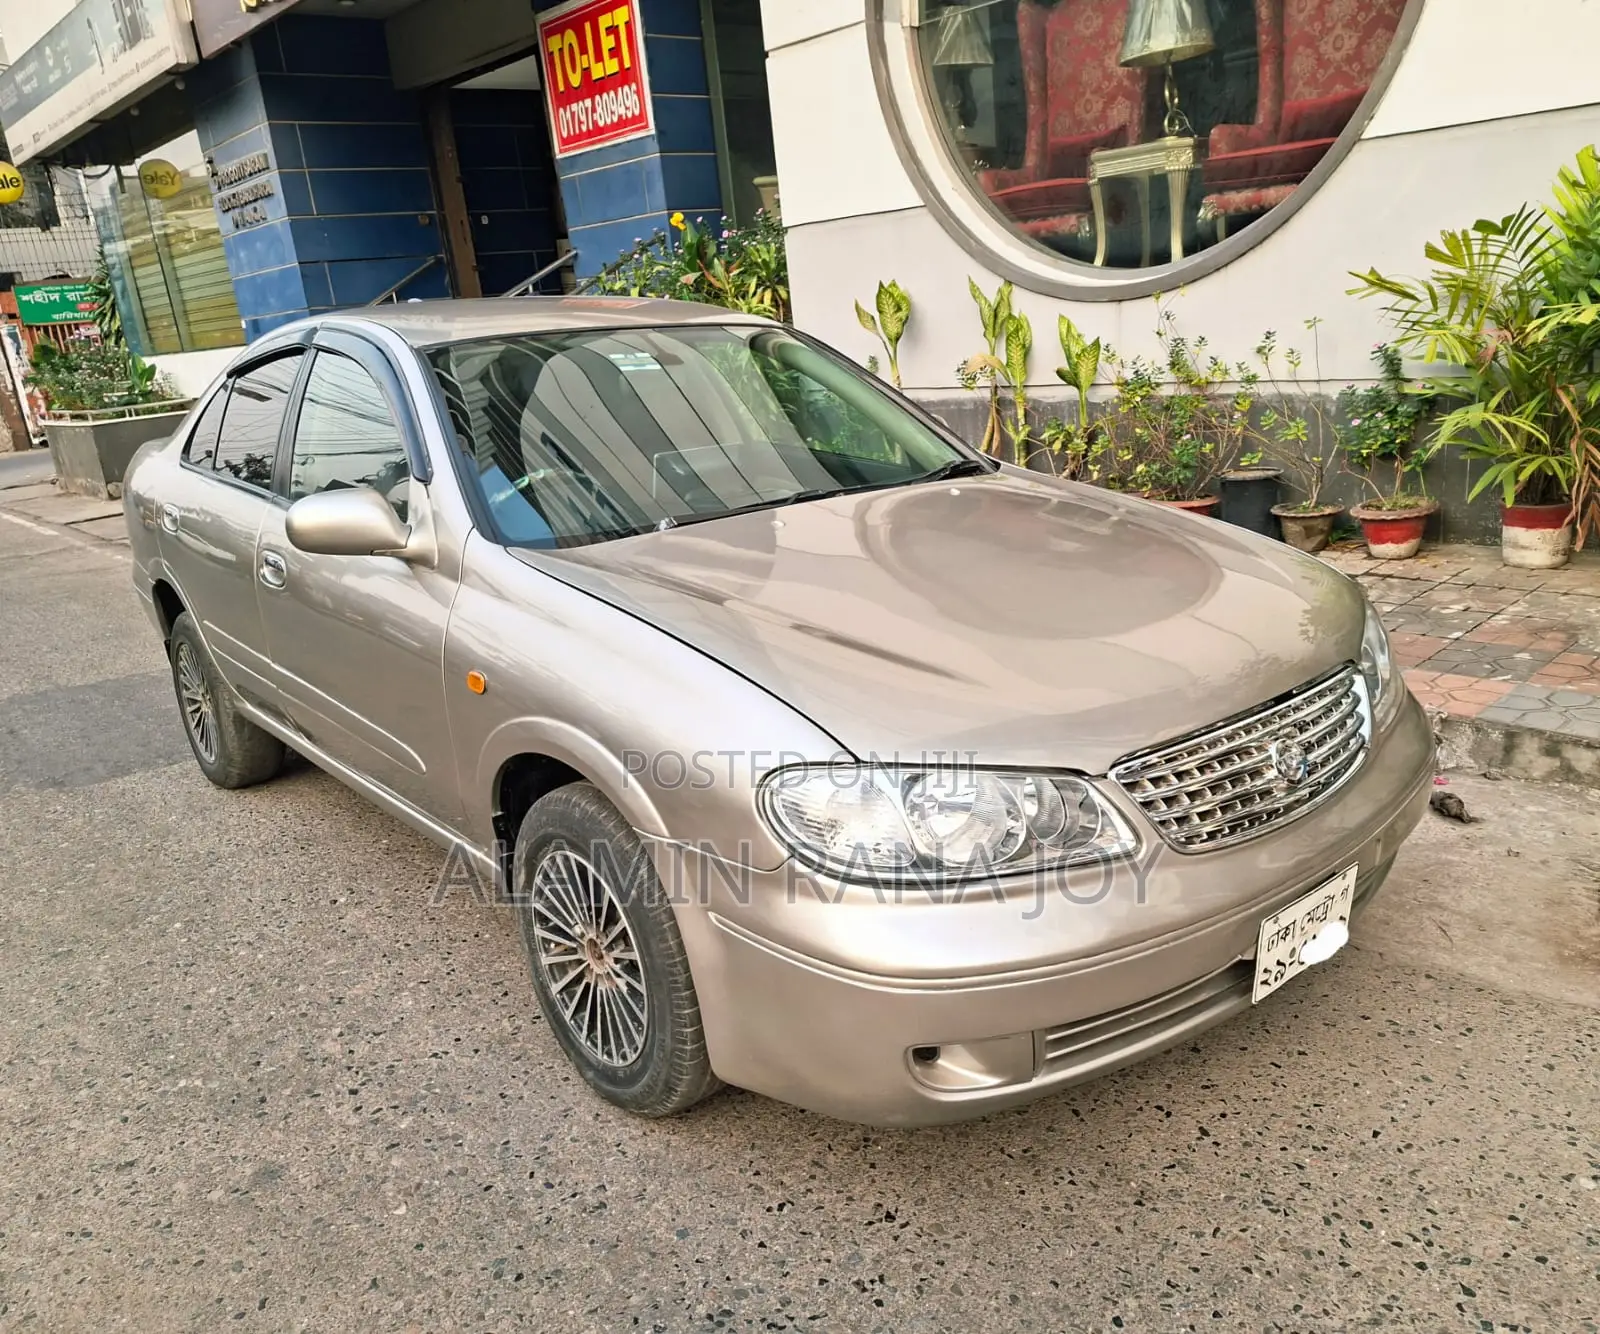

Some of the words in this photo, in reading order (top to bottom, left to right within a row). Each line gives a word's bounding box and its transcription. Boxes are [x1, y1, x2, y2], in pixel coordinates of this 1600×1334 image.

[548, 5, 632, 92] TO-LET
[558, 82, 640, 139] 01797-809496
[1266, 919, 1296, 952] ঢাকা
